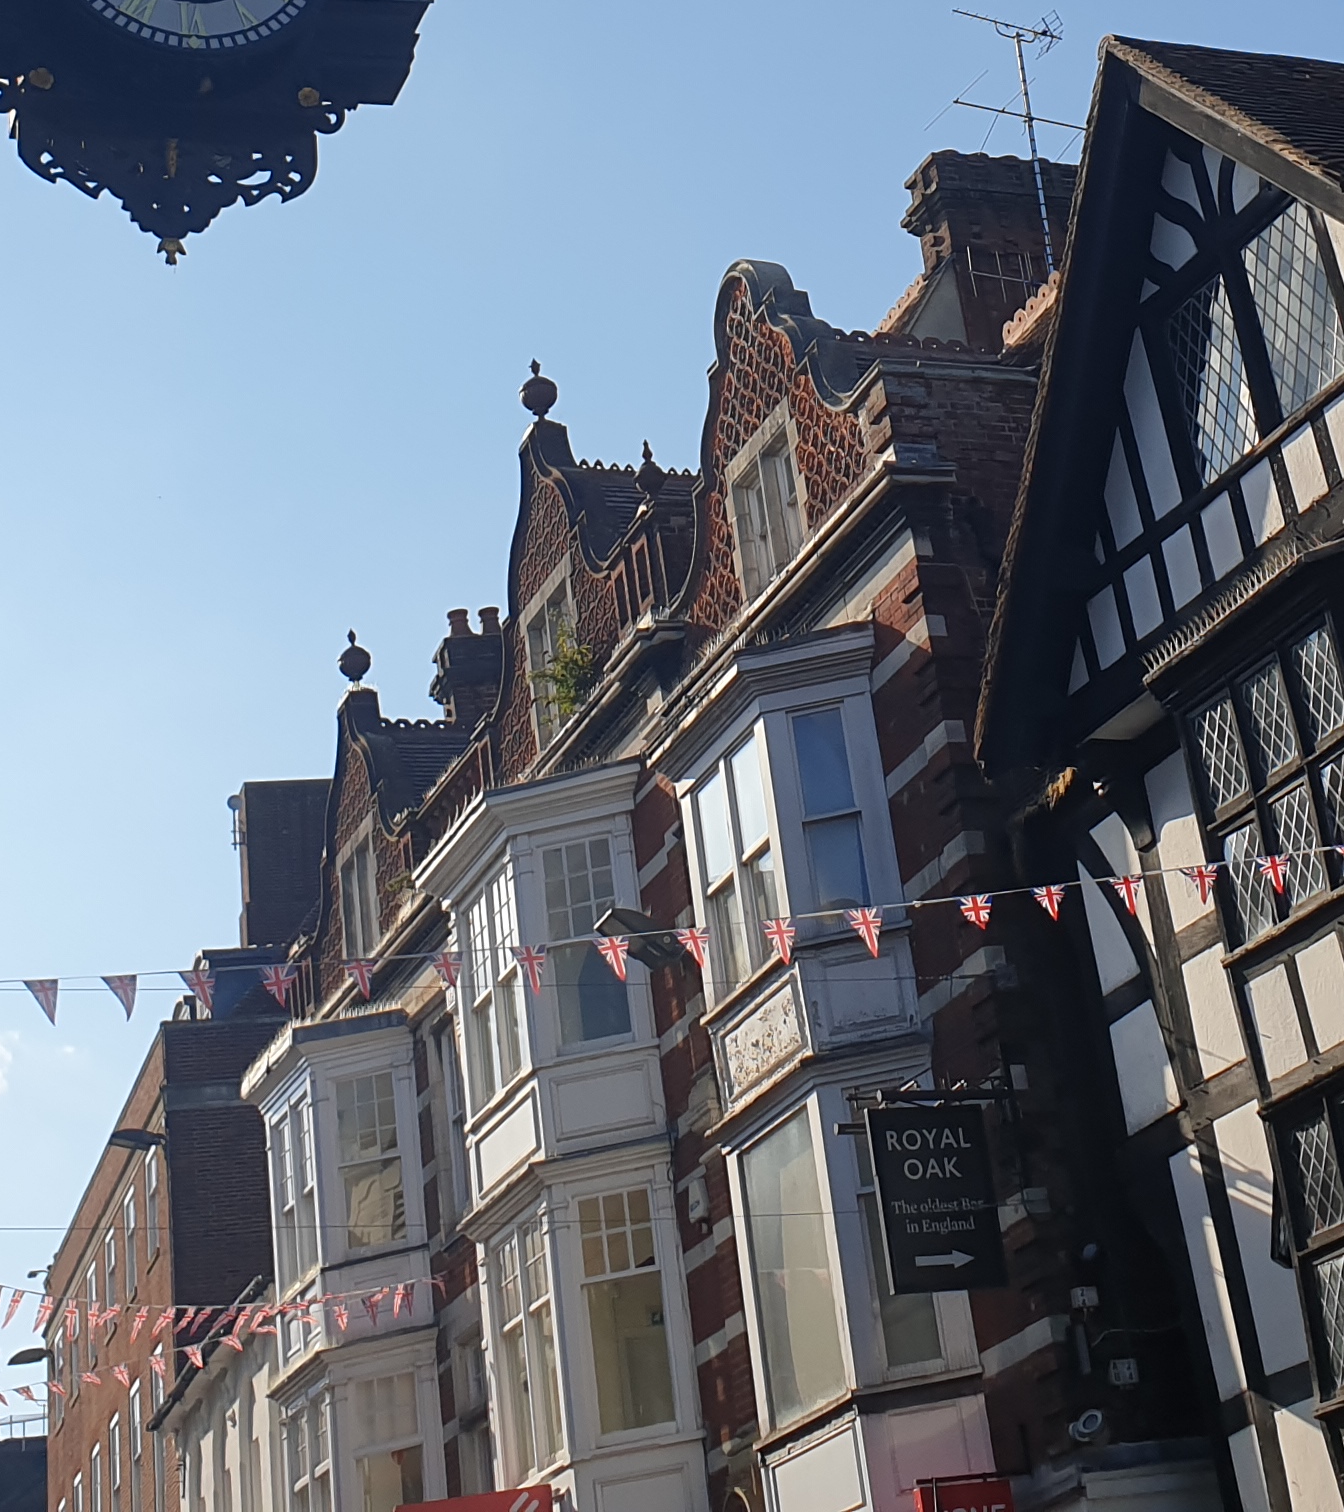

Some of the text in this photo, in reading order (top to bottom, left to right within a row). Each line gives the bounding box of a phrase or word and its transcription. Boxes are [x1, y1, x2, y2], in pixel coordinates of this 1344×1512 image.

[885, 1127, 972, 1151] ROYAL
[903, 1156, 963, 1180] OAK
[891, 1199, 918, 1215] The
[920, 1197, 960, 1213] oldest
[906, 1215, 976, 1234] in England
